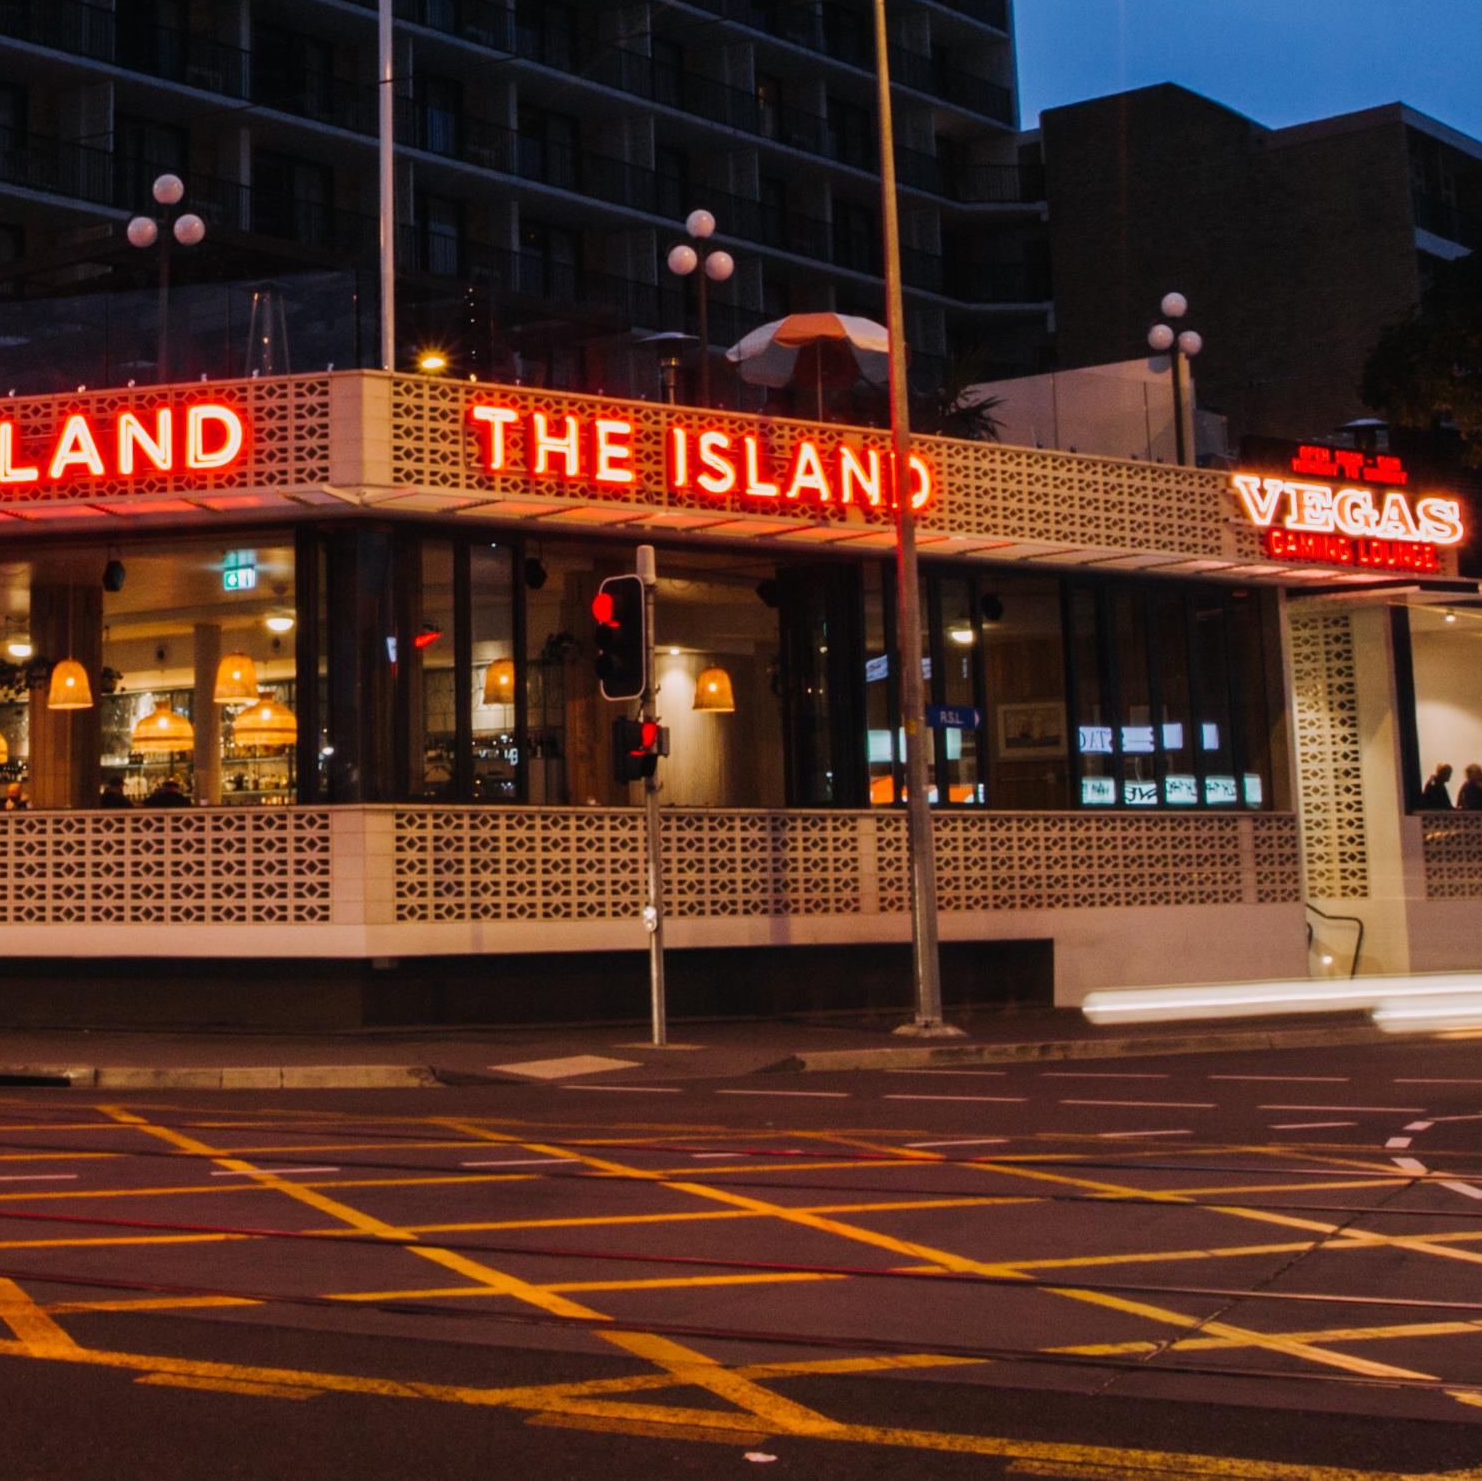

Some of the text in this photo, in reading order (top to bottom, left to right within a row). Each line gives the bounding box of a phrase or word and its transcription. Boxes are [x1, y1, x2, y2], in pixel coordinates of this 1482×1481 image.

[472, 404, 932, 510] THE ISLAND
[1233, 475, 1463, 545] VEGAS
[1270, 529, 1439, 573] GAMING LOUNGE
